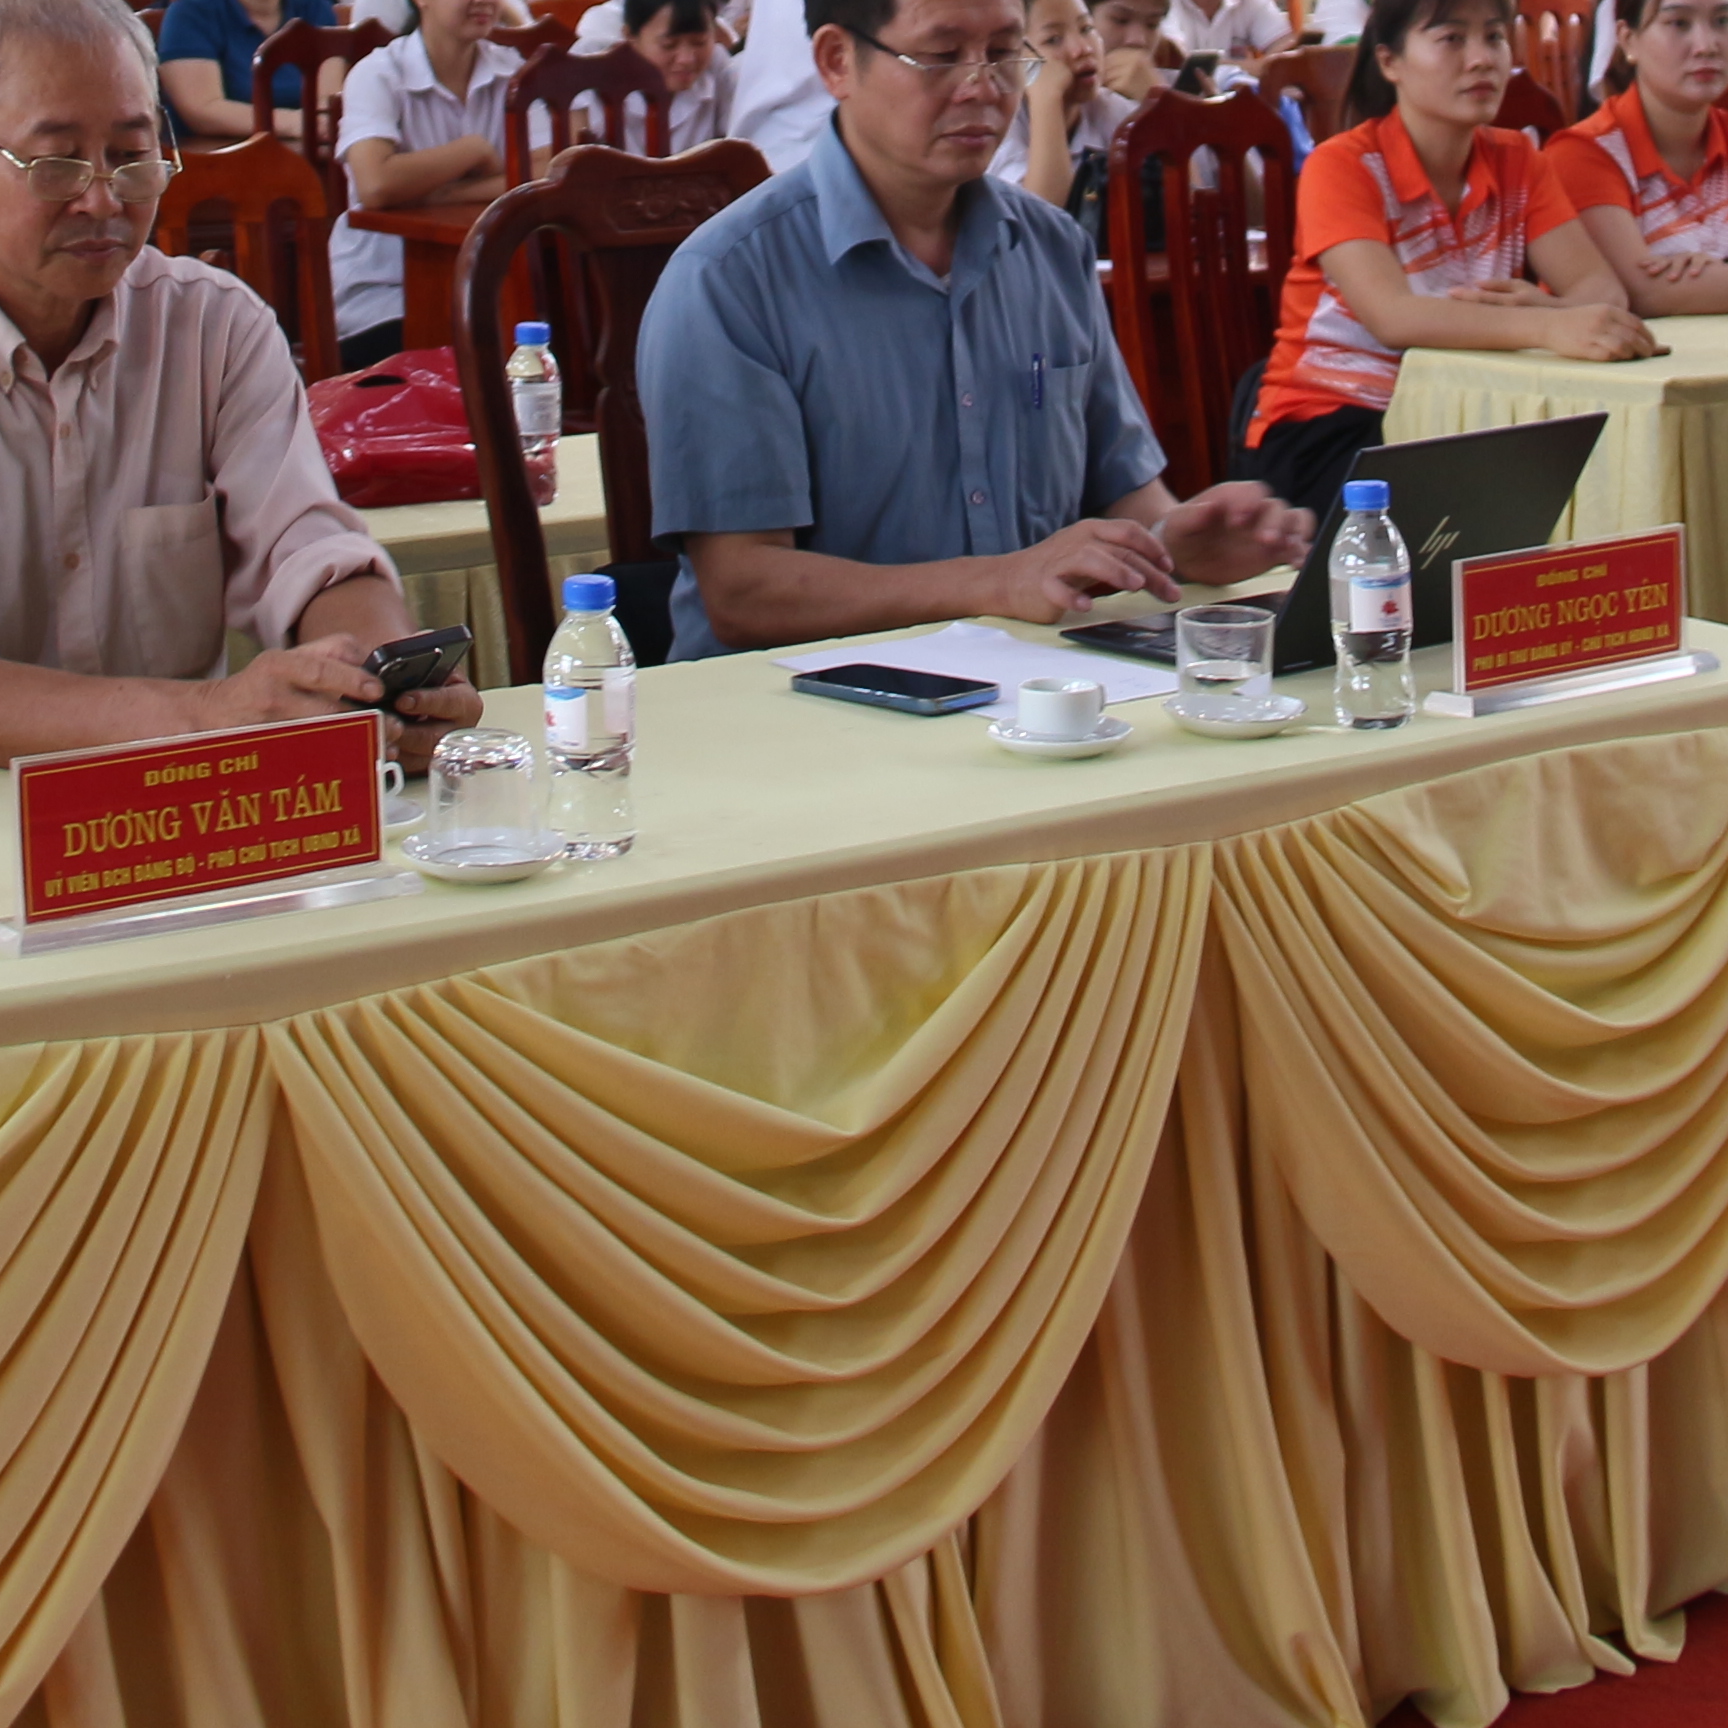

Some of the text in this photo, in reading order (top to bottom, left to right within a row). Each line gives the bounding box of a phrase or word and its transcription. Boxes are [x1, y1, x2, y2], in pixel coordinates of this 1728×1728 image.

[1419, 515, 1461, 570] hp
[1472, 603, 1553, 640] DƯƠNG
[1557, 591, 1619, 625] NGỌC
[218, 751, 259, 775] CHÍ
[63, 775, 342, 857] DƯƠNG VĂN TÁM
